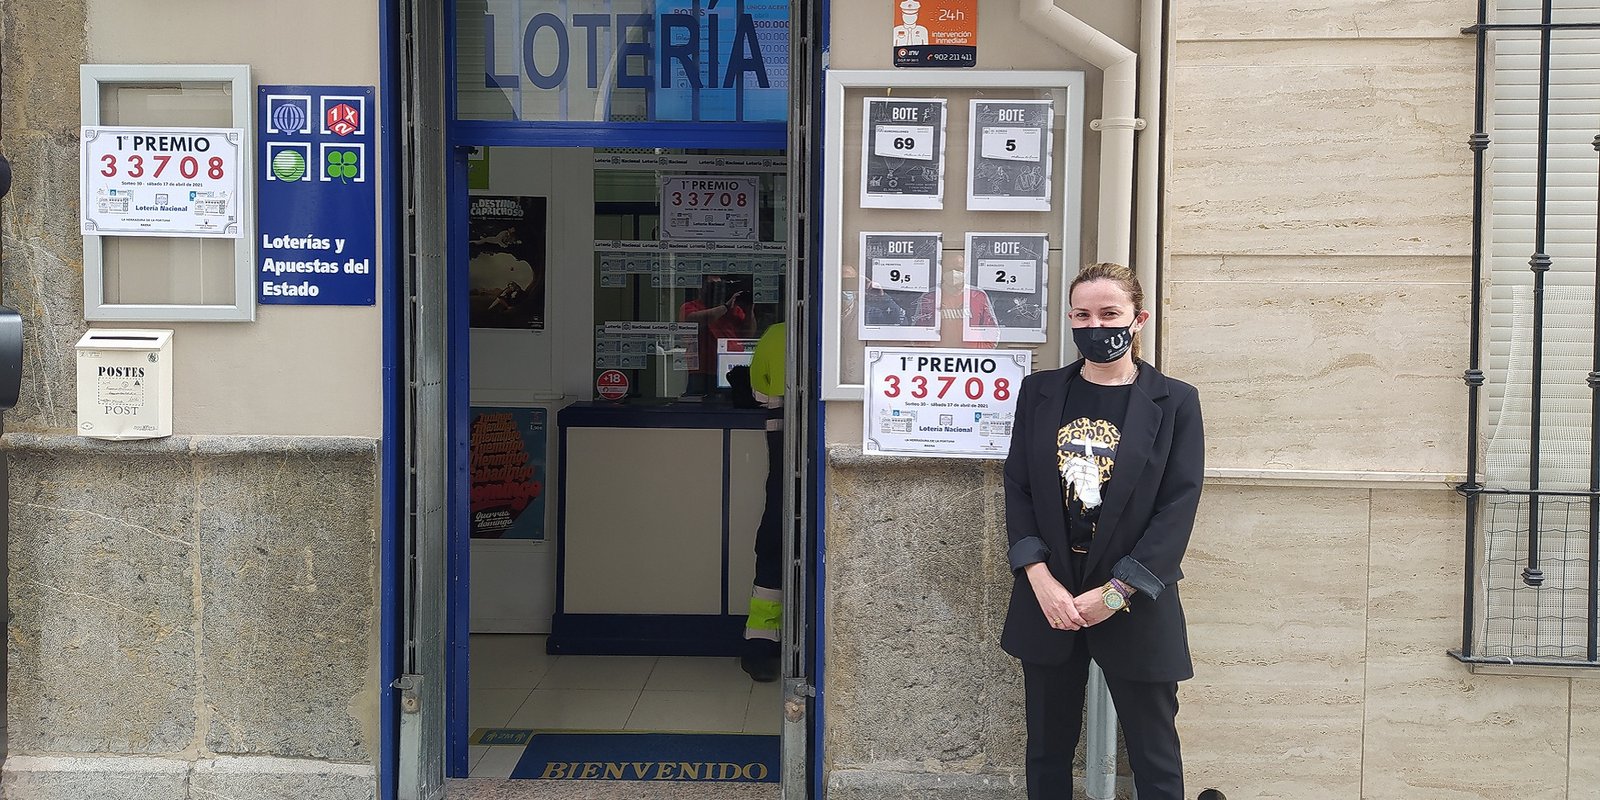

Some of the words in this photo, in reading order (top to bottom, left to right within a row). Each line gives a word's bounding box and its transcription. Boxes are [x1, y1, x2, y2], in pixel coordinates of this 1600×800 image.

[485, 0, 770, 89] LOTERÍA
[892, 108, 918, 120] BOTE
[999, 109, 1025, 121] BOTE
[134, 136, 210, 152] PREMIO
[894, 137, 915, 150] 69
[1006, 139, 1016, 151] 5
[100, 154, 224, 180] 33708
[692, 181, 739, 190] PREMIO
[479, 199, 516, 208] DESTINO
[470, 208, 524, 217] CAPRICHOSO
[263, 234, 330, 250] Loterías
[335, 238, 345, 253] y
[889, 241, 914, 253] BOTE
[994, 242, 1020, 254] BOTE
[262, 258, 339, 276] Apuestas
[344, 259, 369, 274] del
[890, 270, 911, 283] 9,5
[995, 271, 1016, 284] 2,3
[263, 282, 319, 297] Estado
[98, 366, 145, 377] POSTES
[918, 357, 997, 373] PREMIO
[604, 373, 620, 383] +18
[884, 375, 1010, 400] 33708
[104, 406, 139, 416] POST
[539, 762, 769, 780] BIENVENIDO
